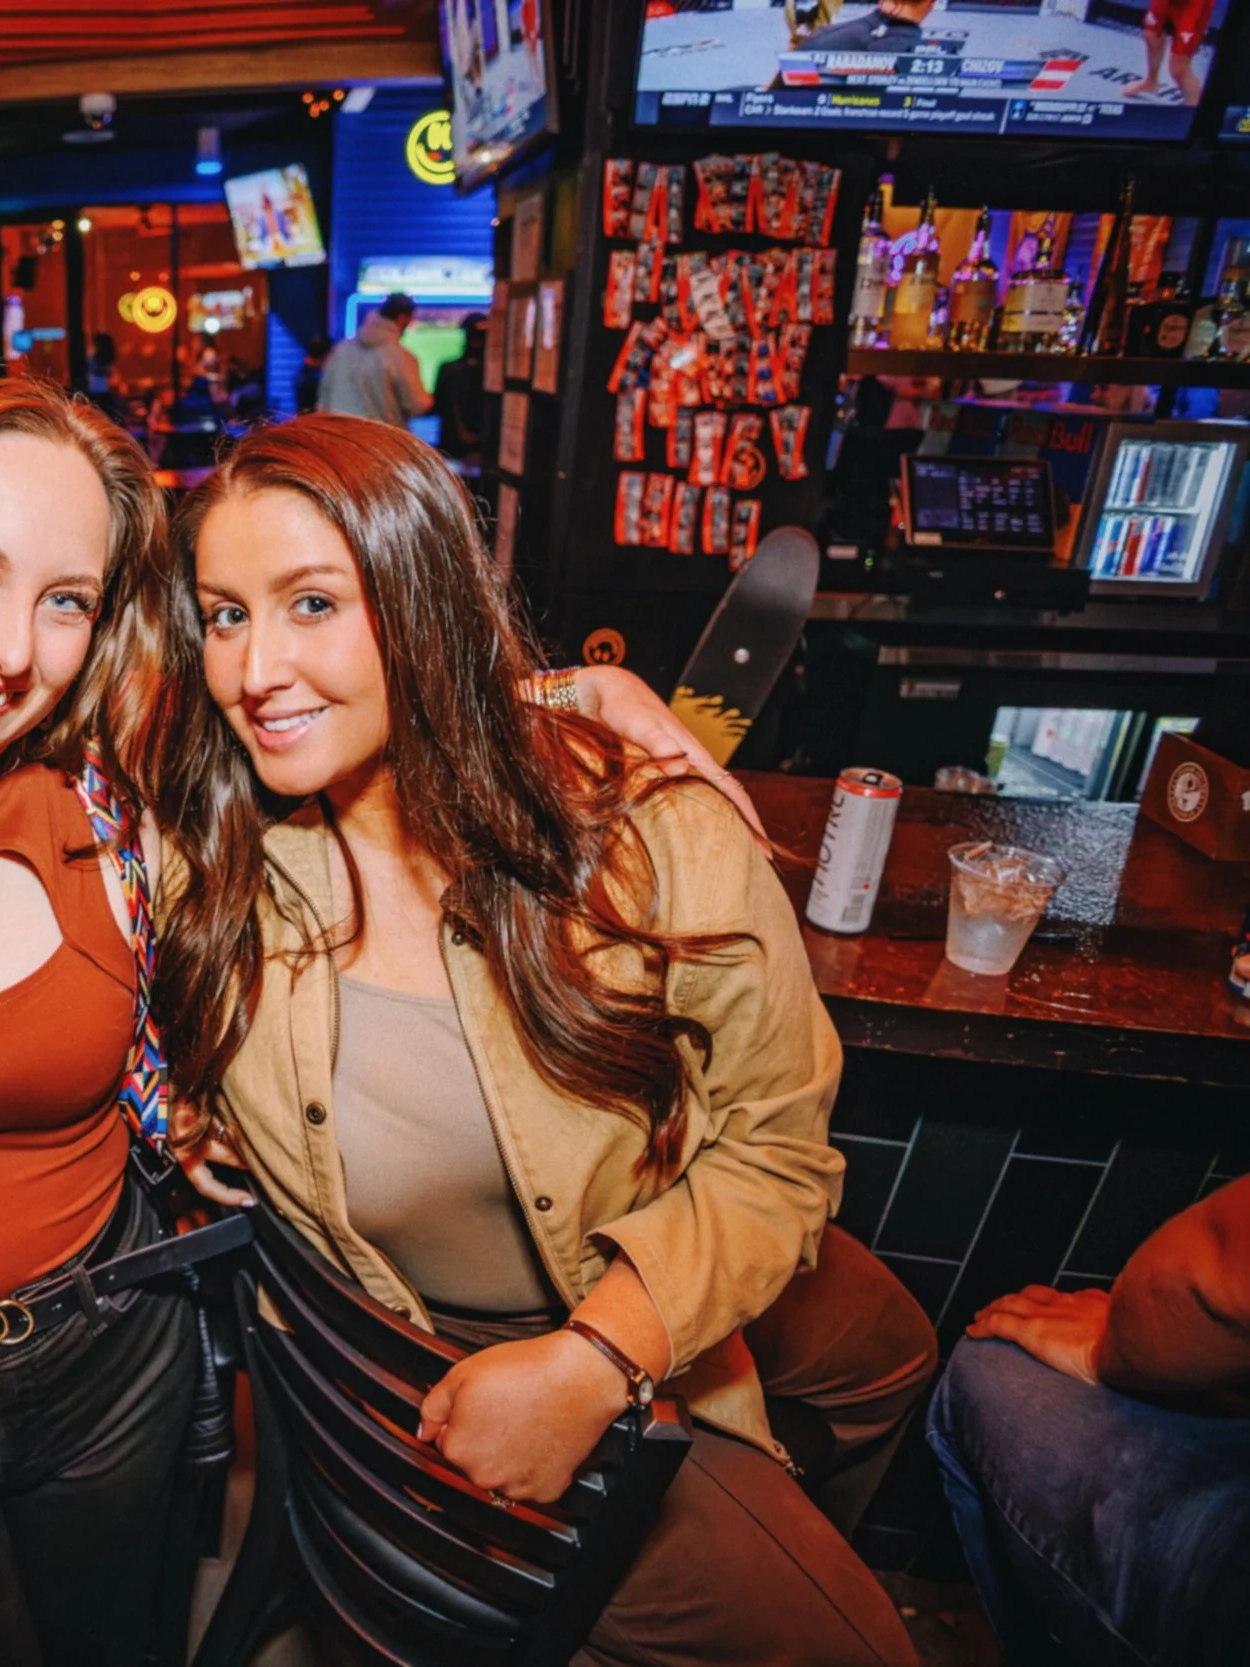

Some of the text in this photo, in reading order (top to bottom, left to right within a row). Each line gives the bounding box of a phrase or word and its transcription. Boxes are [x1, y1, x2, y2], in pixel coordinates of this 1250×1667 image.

[910, 59, 944, 73] 2:13
[832, 94, 881, 107] Hurricanes
[1050, 418, 1095, 454] Bull
